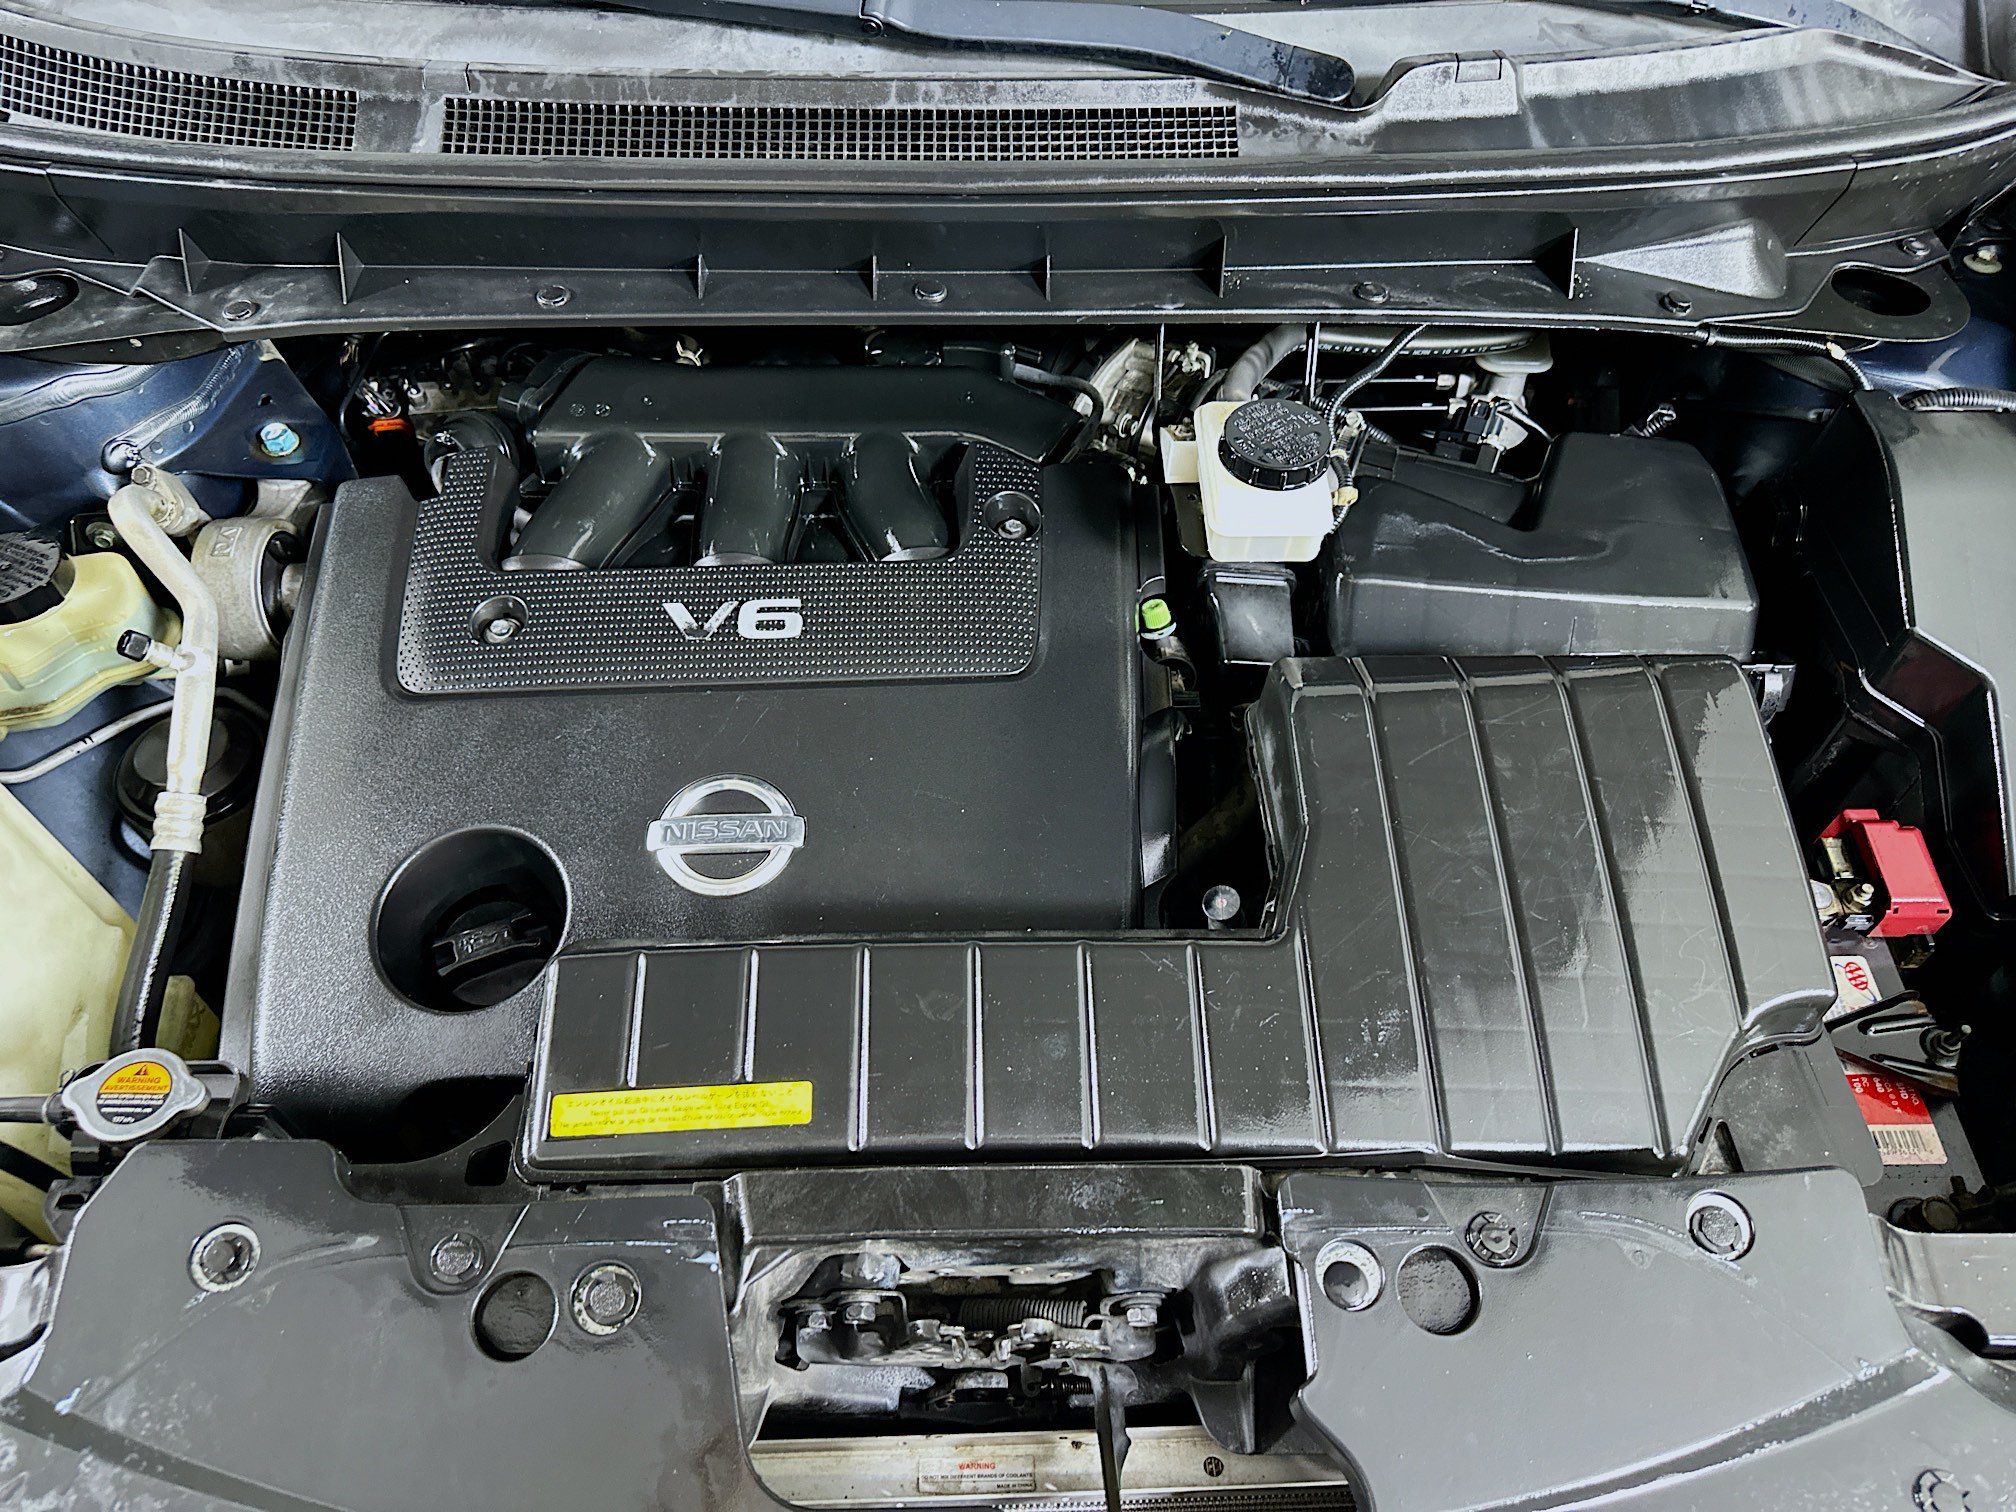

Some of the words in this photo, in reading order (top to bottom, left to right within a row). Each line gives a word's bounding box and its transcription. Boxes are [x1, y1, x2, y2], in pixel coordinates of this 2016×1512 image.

[662, 598, 804, 641] V6
[662, 819, 788, 843] NISSAN
[1851, 1077, 1864, 1094] 100
[959, 1462, 996, 1470] WARNING
